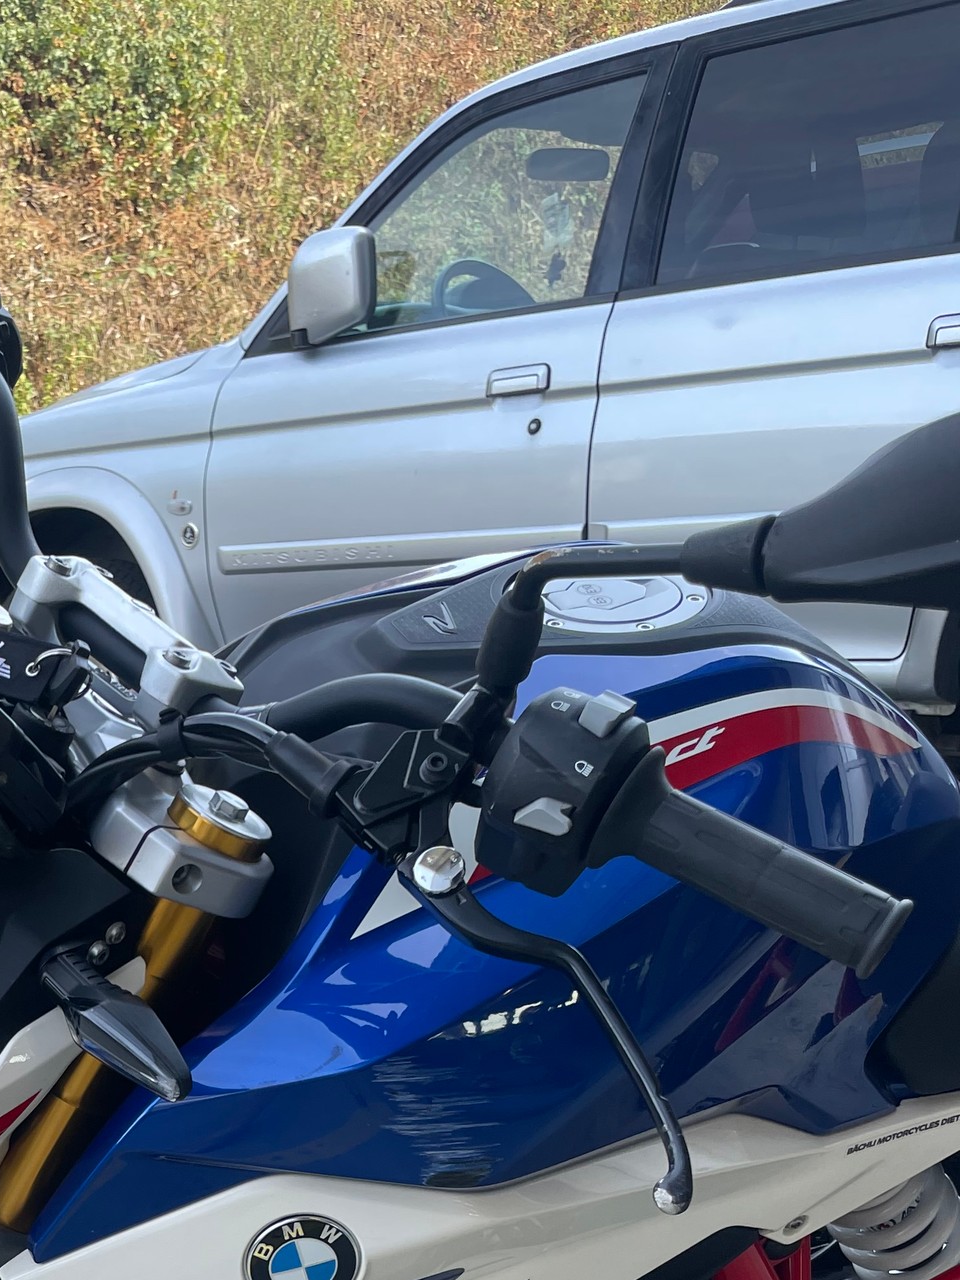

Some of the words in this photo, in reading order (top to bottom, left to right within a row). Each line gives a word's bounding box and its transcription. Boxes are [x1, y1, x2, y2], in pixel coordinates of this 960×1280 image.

[846, 1138, 877, 1156] BÄCHLI
[876, 1119, 941, 1146] MOTORCYCLES
[252, 1221, 343, 1261] BMW
